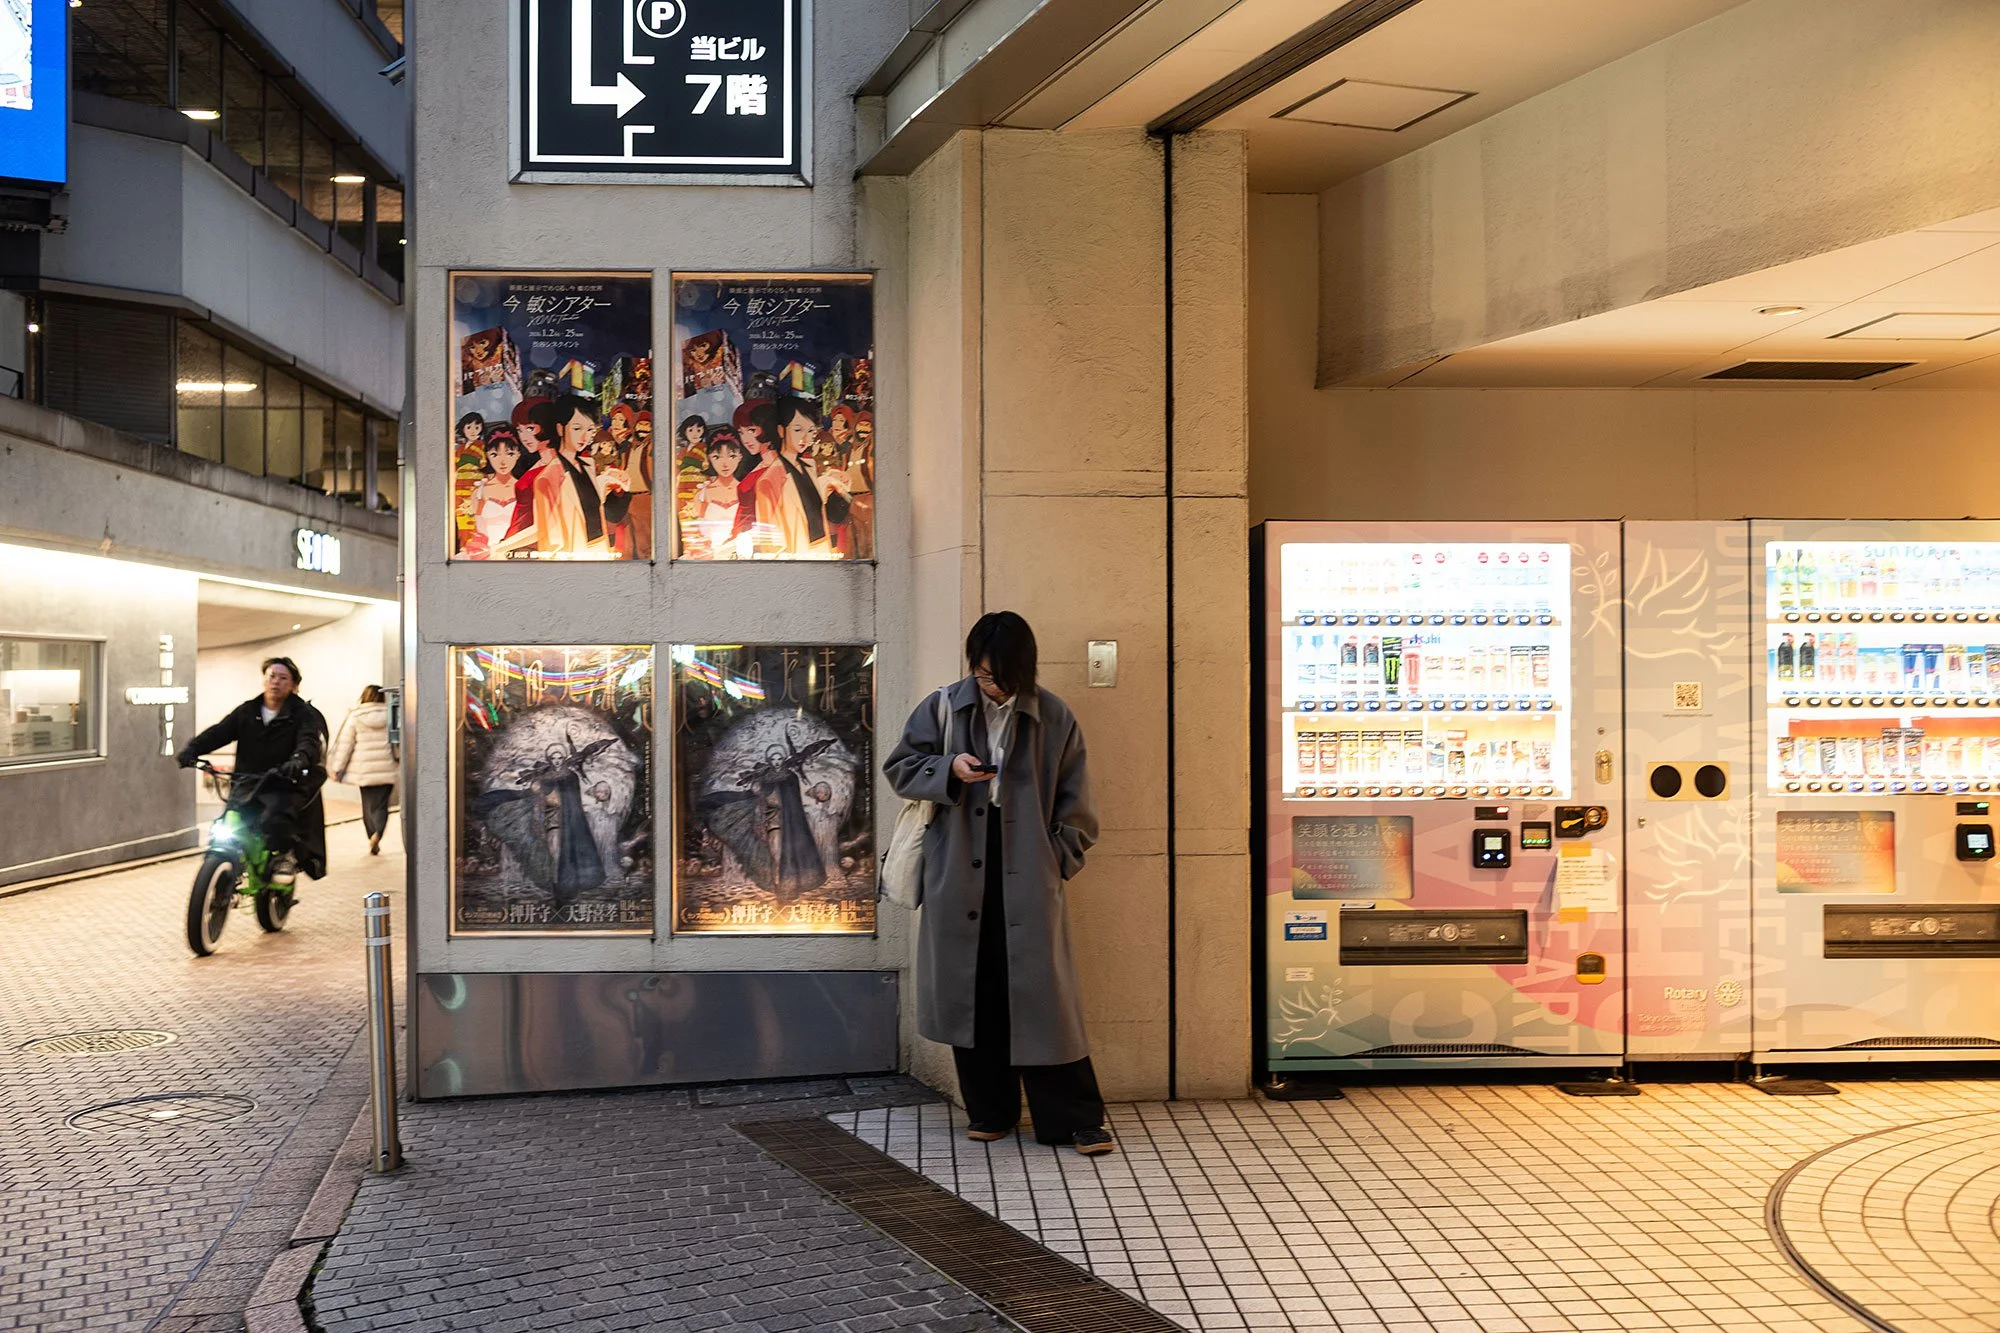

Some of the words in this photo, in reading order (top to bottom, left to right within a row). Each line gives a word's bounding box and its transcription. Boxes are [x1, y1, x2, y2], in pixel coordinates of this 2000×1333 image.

[690, 36, 766, 62] 当ビル
[685, 74, 768, 116] 7階
[1664, 985, 1708, 1002] Rotary
